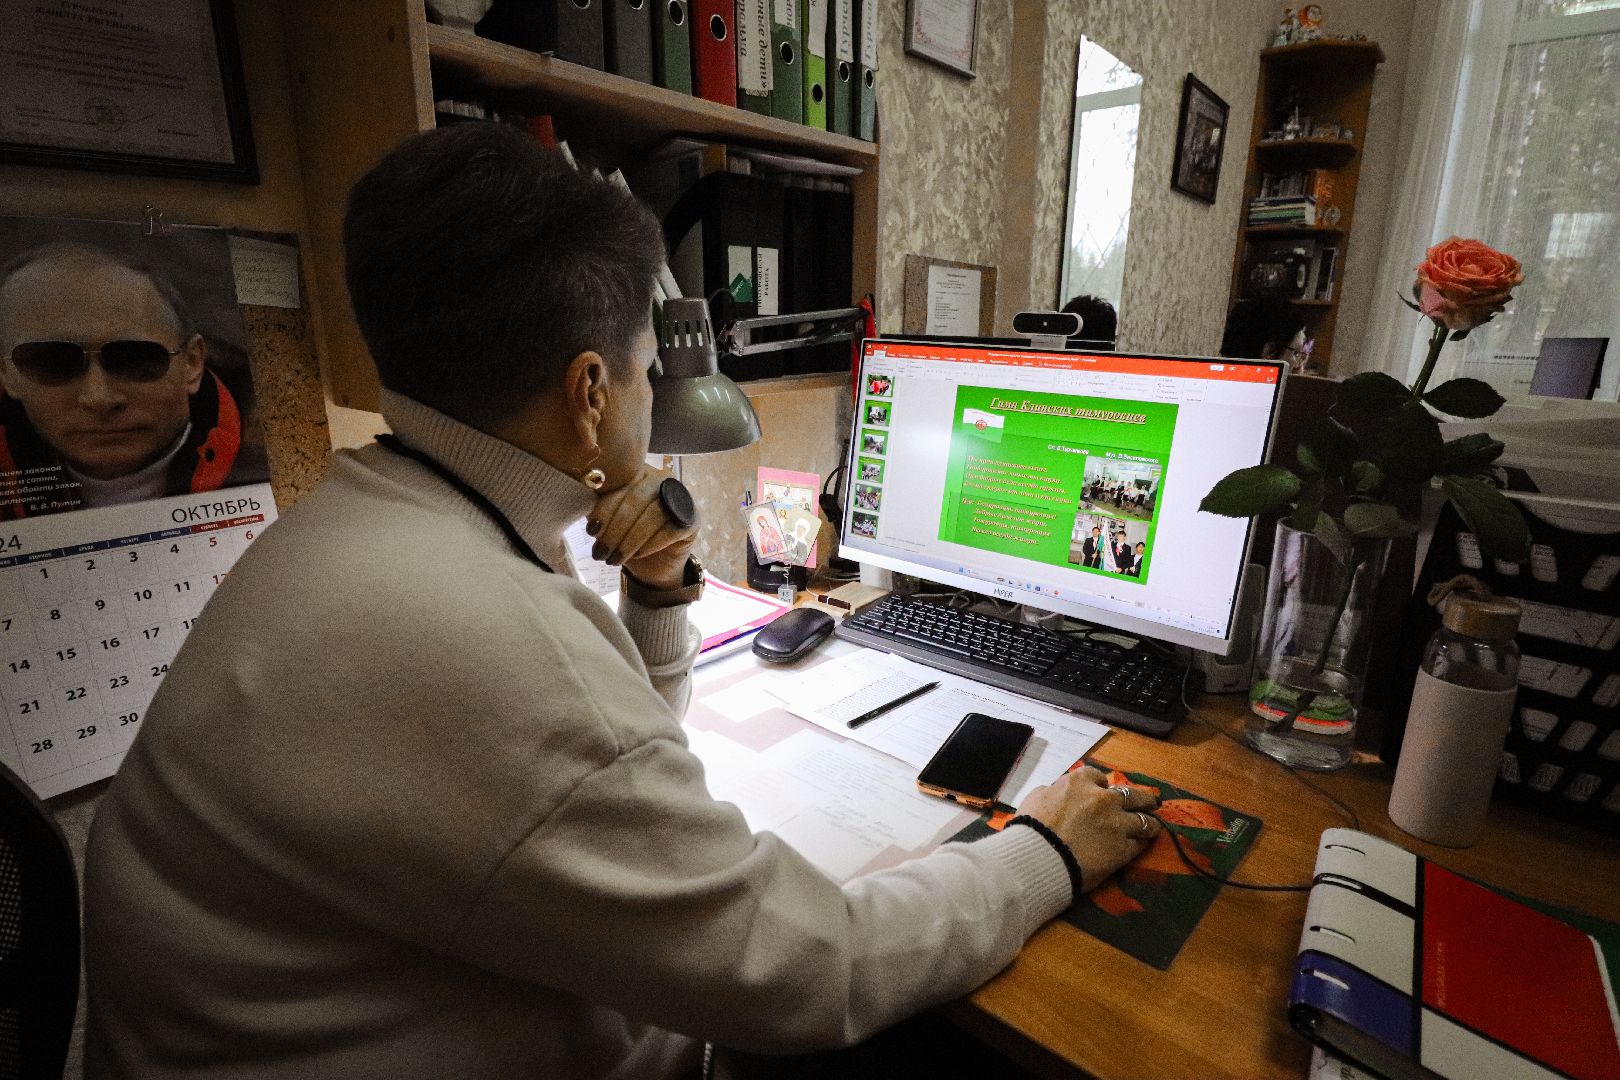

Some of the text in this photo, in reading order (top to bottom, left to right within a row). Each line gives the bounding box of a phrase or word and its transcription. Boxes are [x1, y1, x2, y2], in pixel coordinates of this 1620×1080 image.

[758, 39, 768, 89] дети»
[990, 397, 1147, 423] Гимн Клинских тимуровцев
[16, 484, 54, 495] обойти
[24, 465, 62, 475] законов
[30, 504, 40, 512] В.
[50, 499, 82, 510] Путин
[171, 497, 261, 524] ОКТЯБРЬ
[40, 530, 254, 579] 1 2 3 4 5 6
[2, 620, 12, 631] 7
[50, 609, 61, 621] 8
[94, 599, 106, 611] 9
[133, 589, 153, 601] 10
[174, 581, 191, 592] 11
[9, 660, 31, 673] 14
[56, 648, 77, 661] 15
[100, 637, 121, 651] 16
[143, 627, 160, 640] 17
[19, 664, 169, 714] 21 22 23 24
[31, 712, 139, 754] 28 29 30
